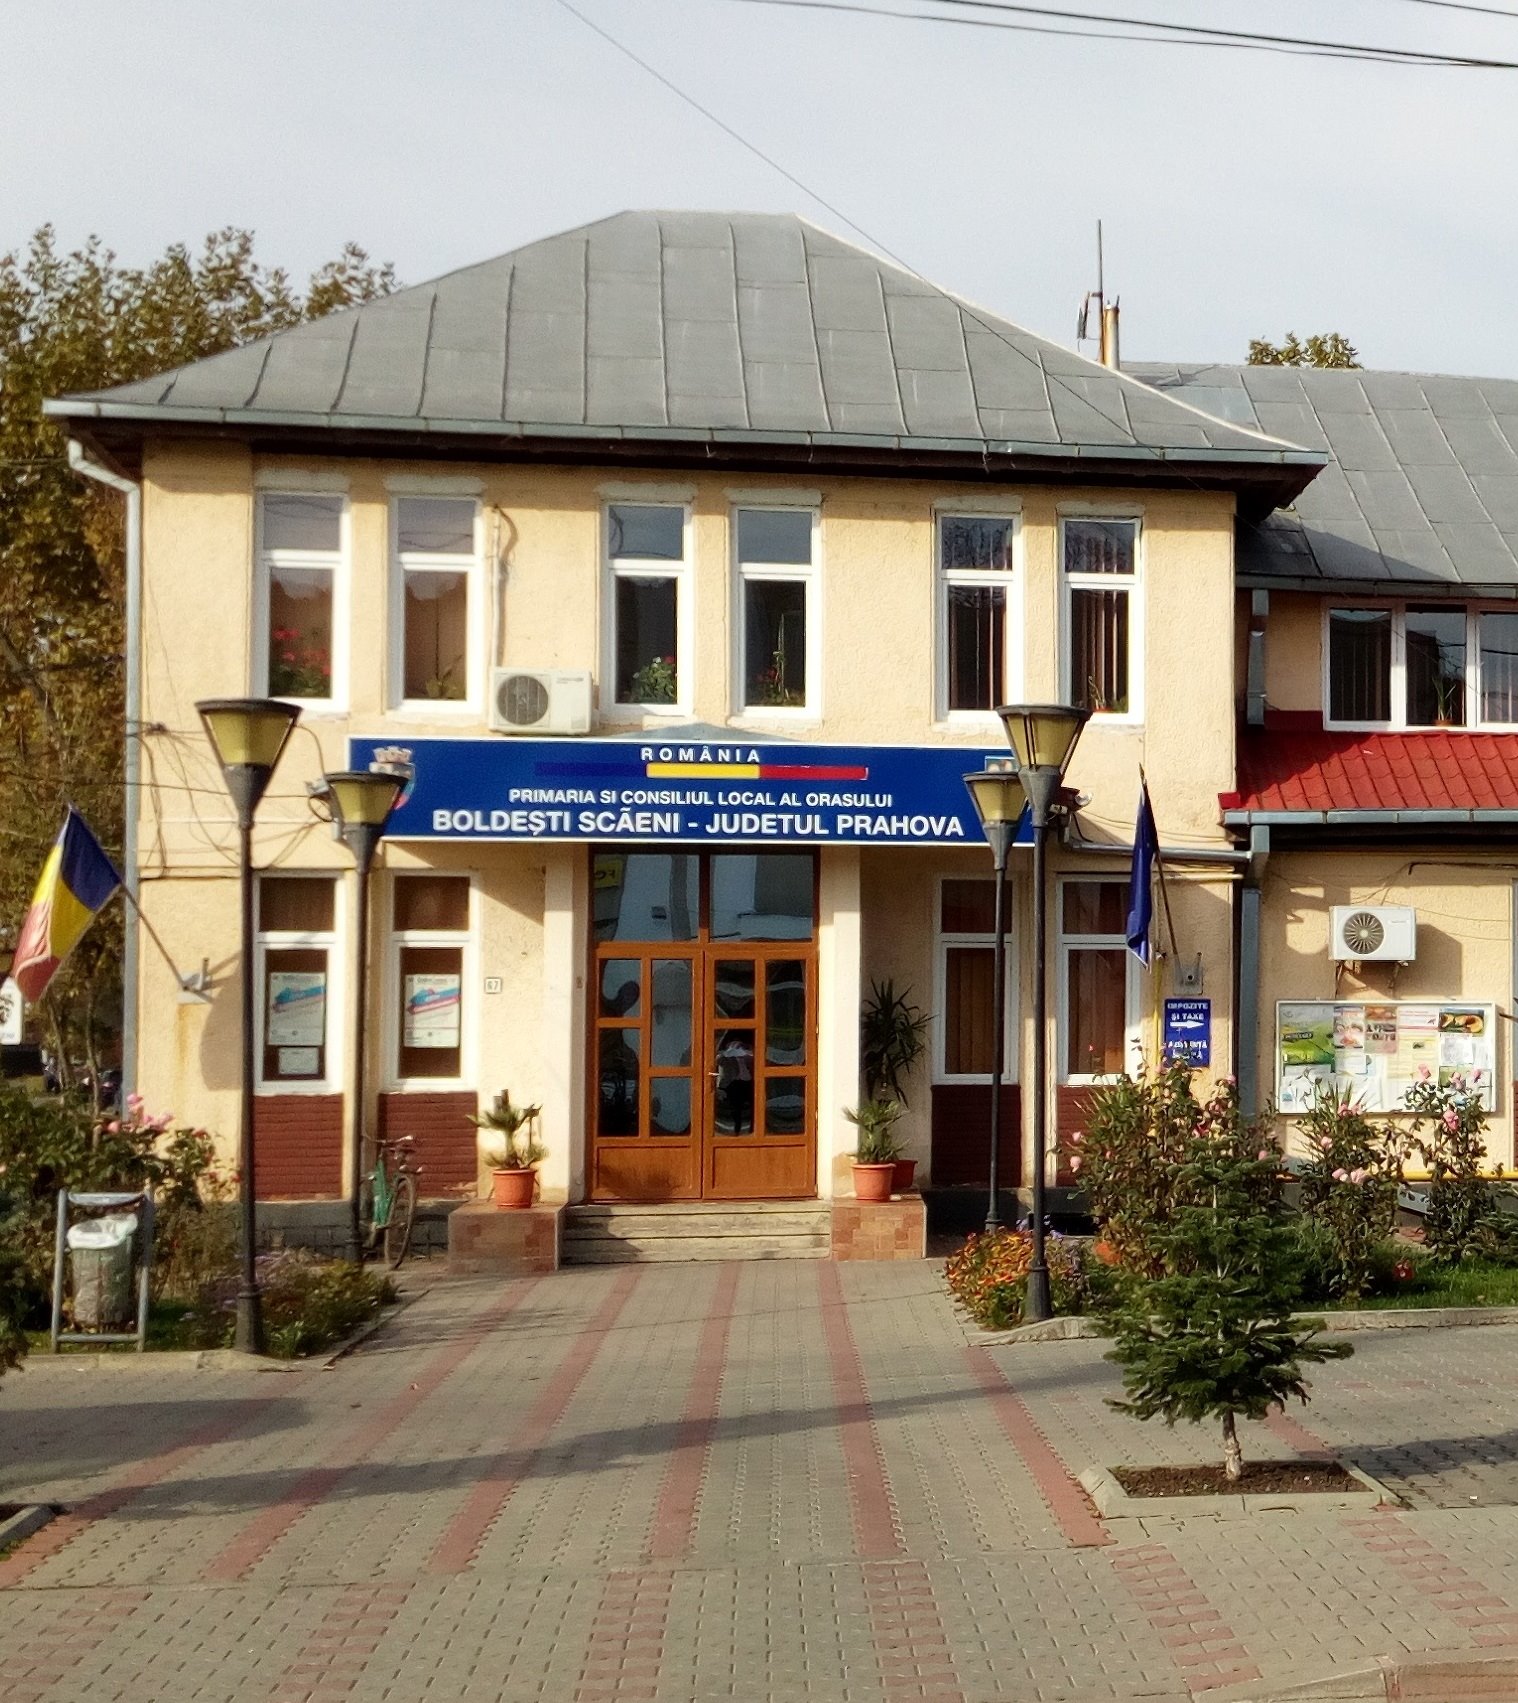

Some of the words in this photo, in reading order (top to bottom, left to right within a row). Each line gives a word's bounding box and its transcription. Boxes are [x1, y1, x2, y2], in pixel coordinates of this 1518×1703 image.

[640, 745, 760, 763] ROMÂNIA
[509, 789, 596, 804] PRIMARIA
[600, 790, 616, 805] SI
[620, 790, 713, 806] CONSILIUL
[718, 791, 775, 806] LOCAL
[779, 792, 802, 807] AL
[805, 792, 892, 808] ORASULUI
[705, 813, 829, 835] JUDETUL
[836, 815, 965, 836] PRAHOVA
